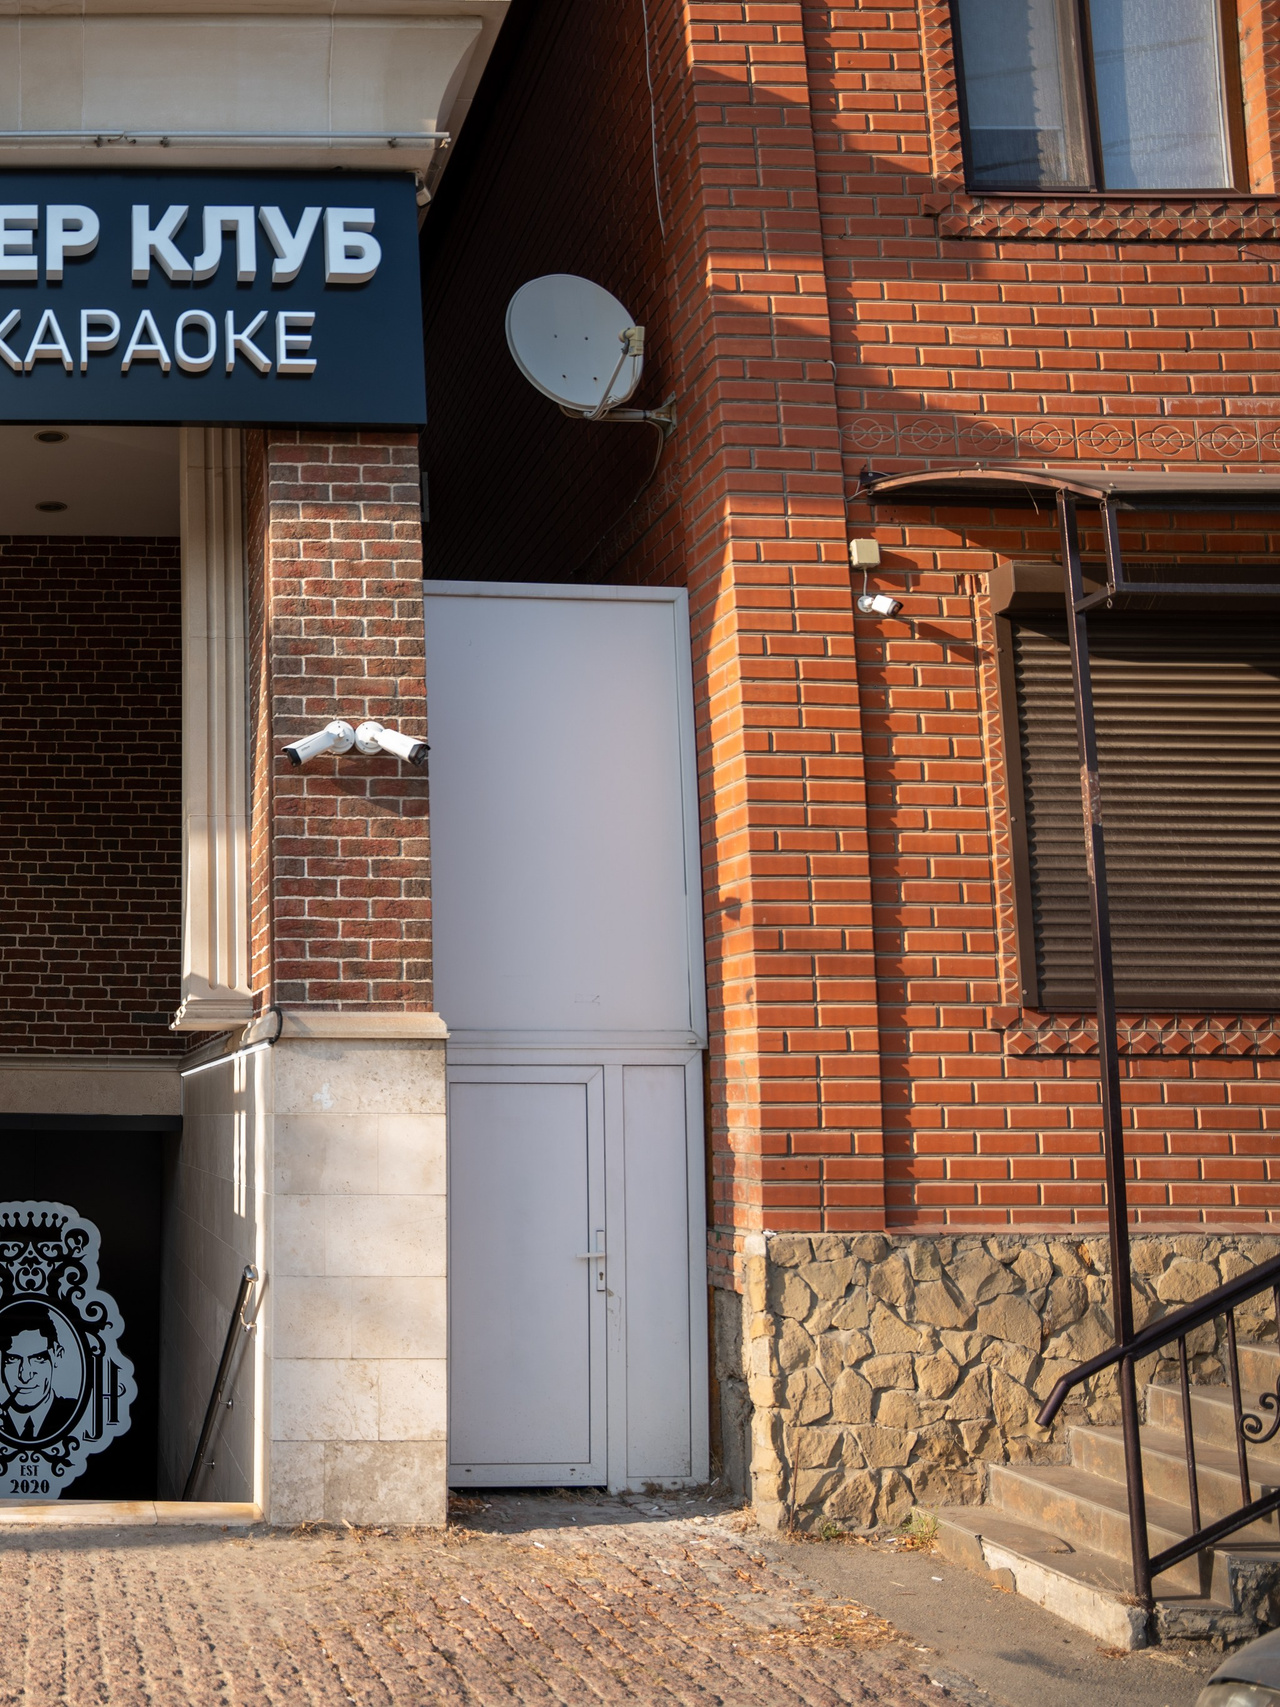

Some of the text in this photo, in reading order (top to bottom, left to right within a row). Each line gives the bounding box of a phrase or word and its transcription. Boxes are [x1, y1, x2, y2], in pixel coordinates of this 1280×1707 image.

[131, 204, 382, 284] КЛУБ
[20, 1464, 39, 1477] EST
[9, 1479, 50, 1494] 2020
